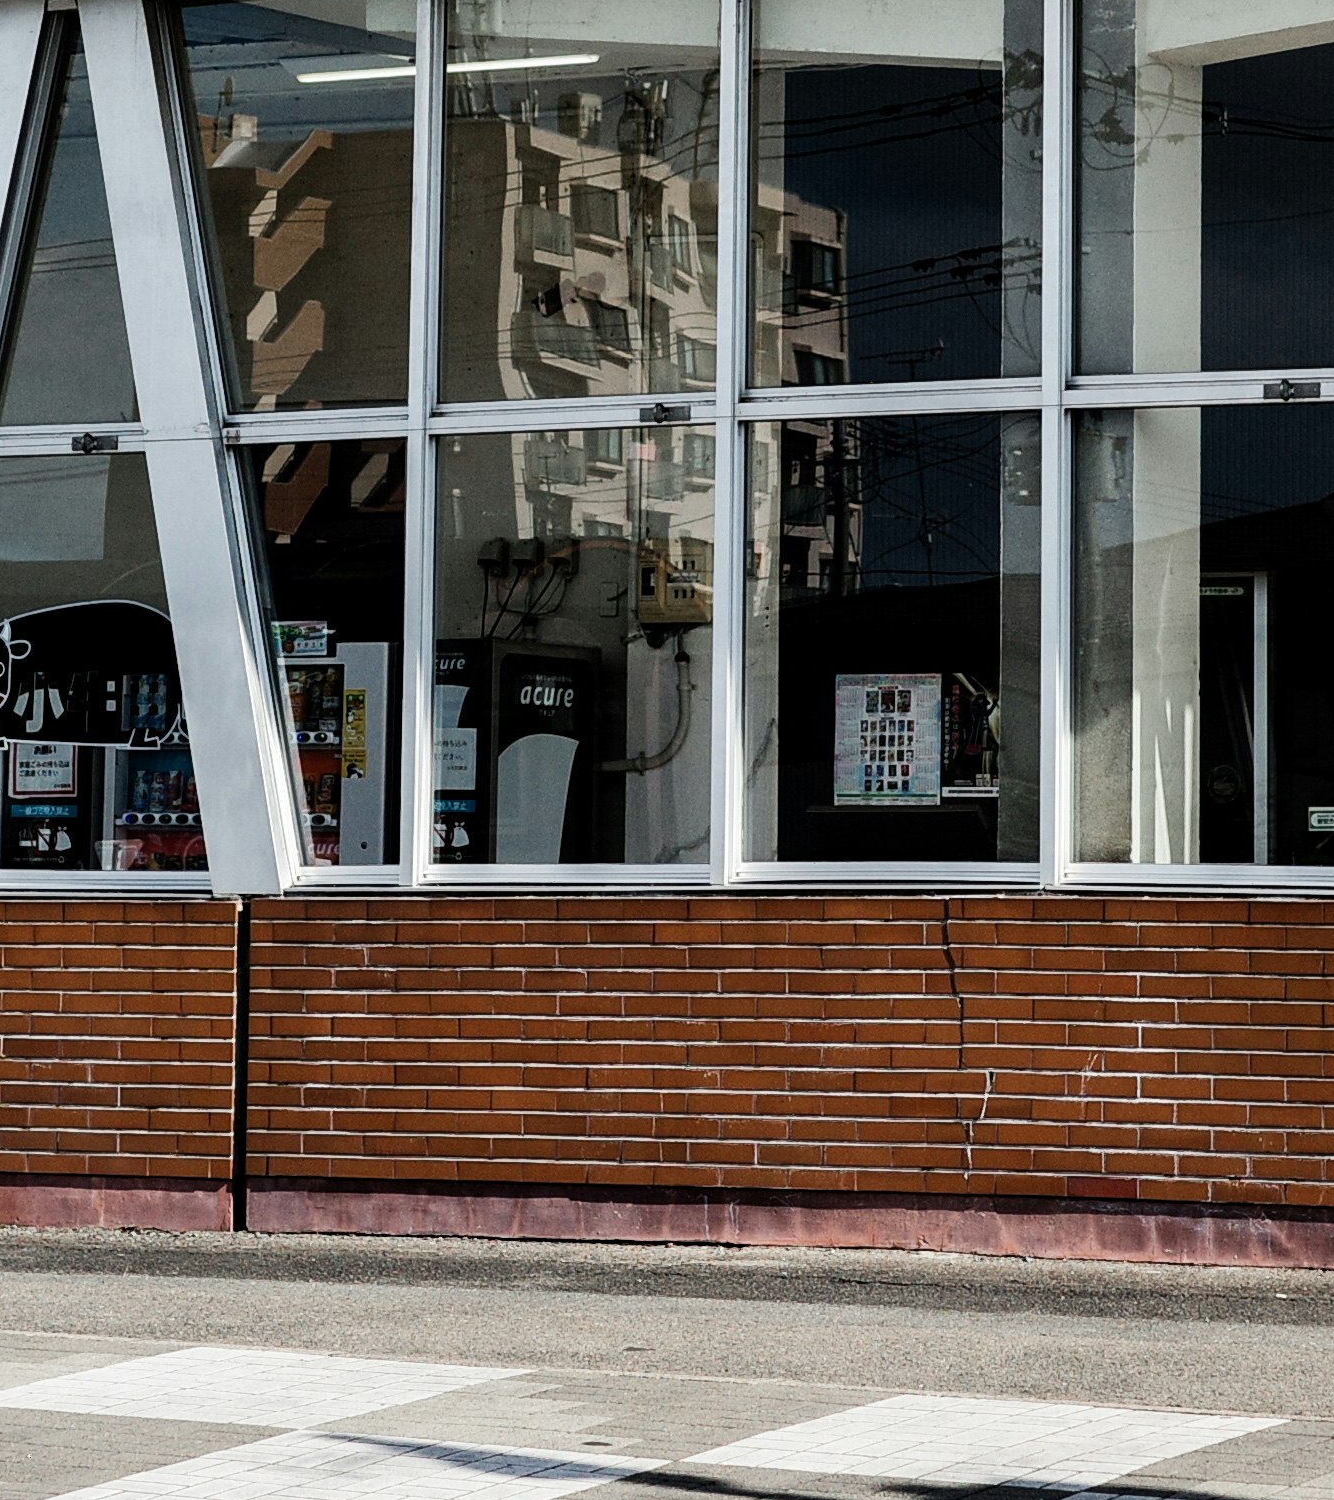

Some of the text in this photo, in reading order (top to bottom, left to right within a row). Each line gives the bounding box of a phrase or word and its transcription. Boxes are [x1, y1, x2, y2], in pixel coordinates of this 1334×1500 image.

[13, 671, 167, 733] 小牛田
[520, 685, 574, 707] acure
